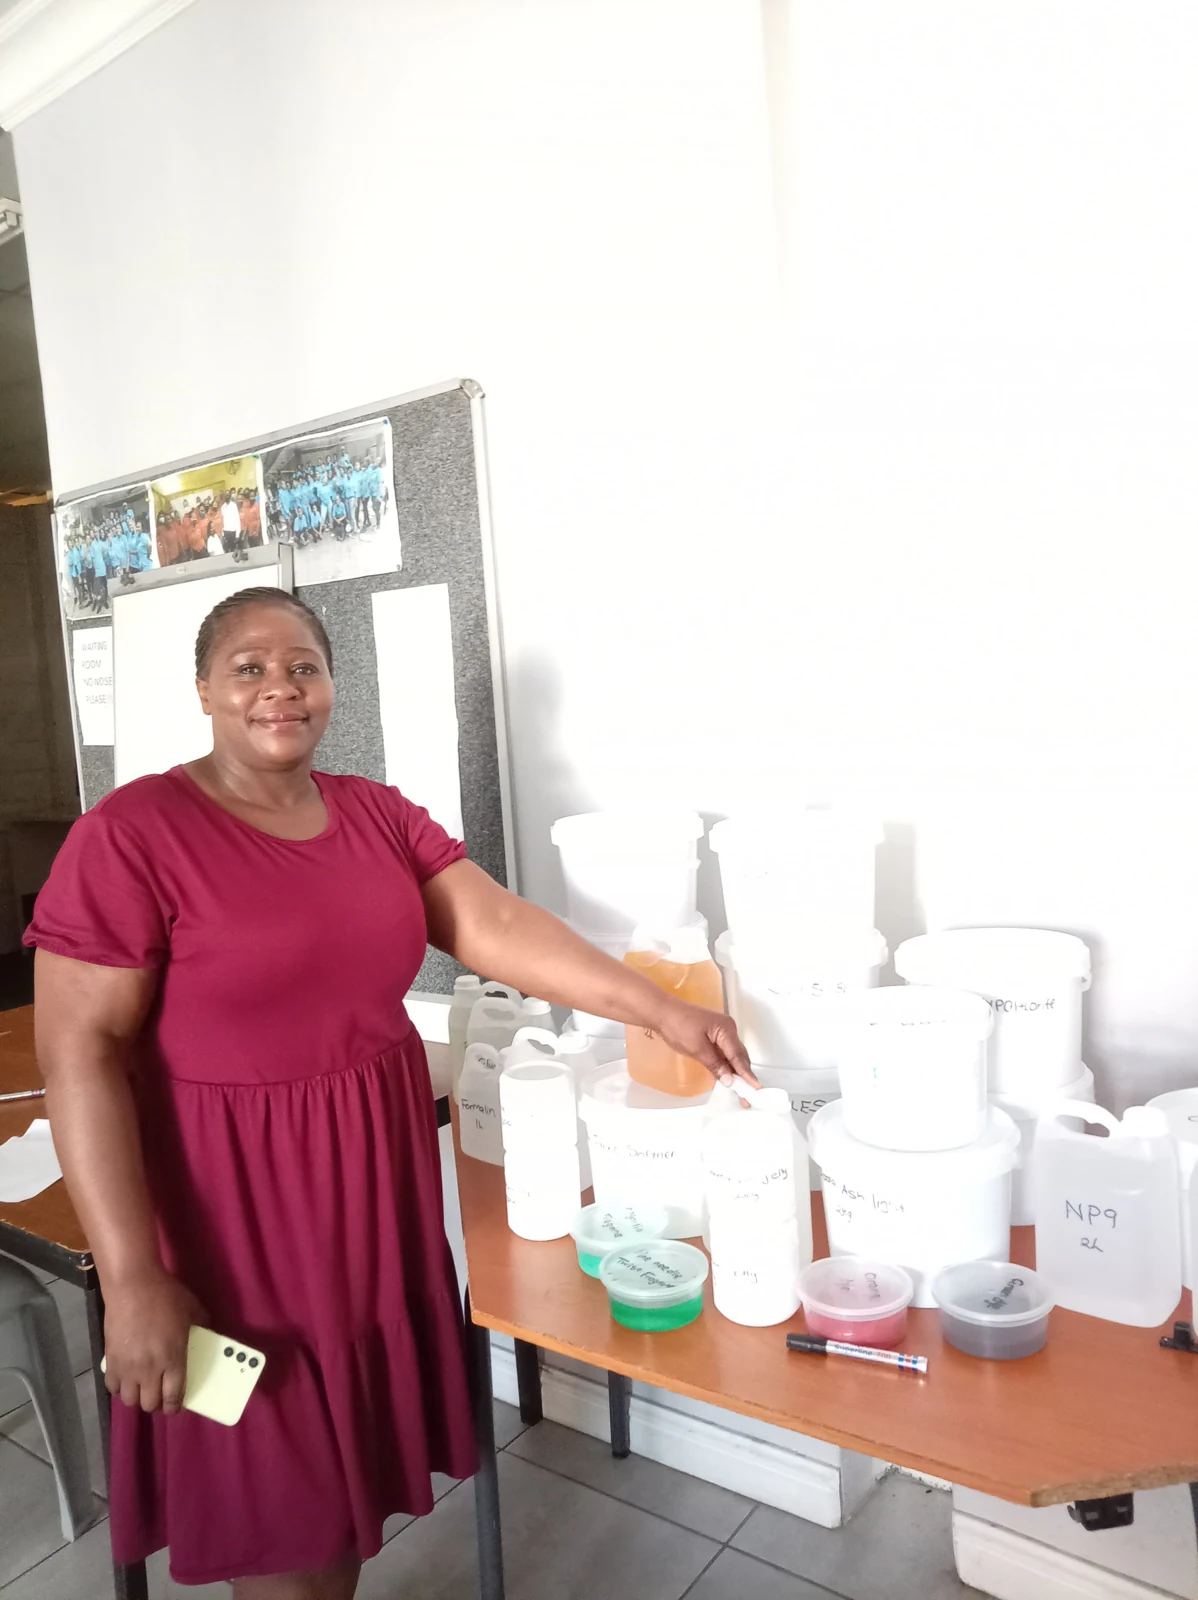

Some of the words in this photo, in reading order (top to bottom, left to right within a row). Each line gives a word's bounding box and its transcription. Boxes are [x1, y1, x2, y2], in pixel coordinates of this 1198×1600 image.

[82, 641, 108, 651] WAITING
[82, 659, 102, 670] ROOM
[834, 1343, 873, 1357] Superline
